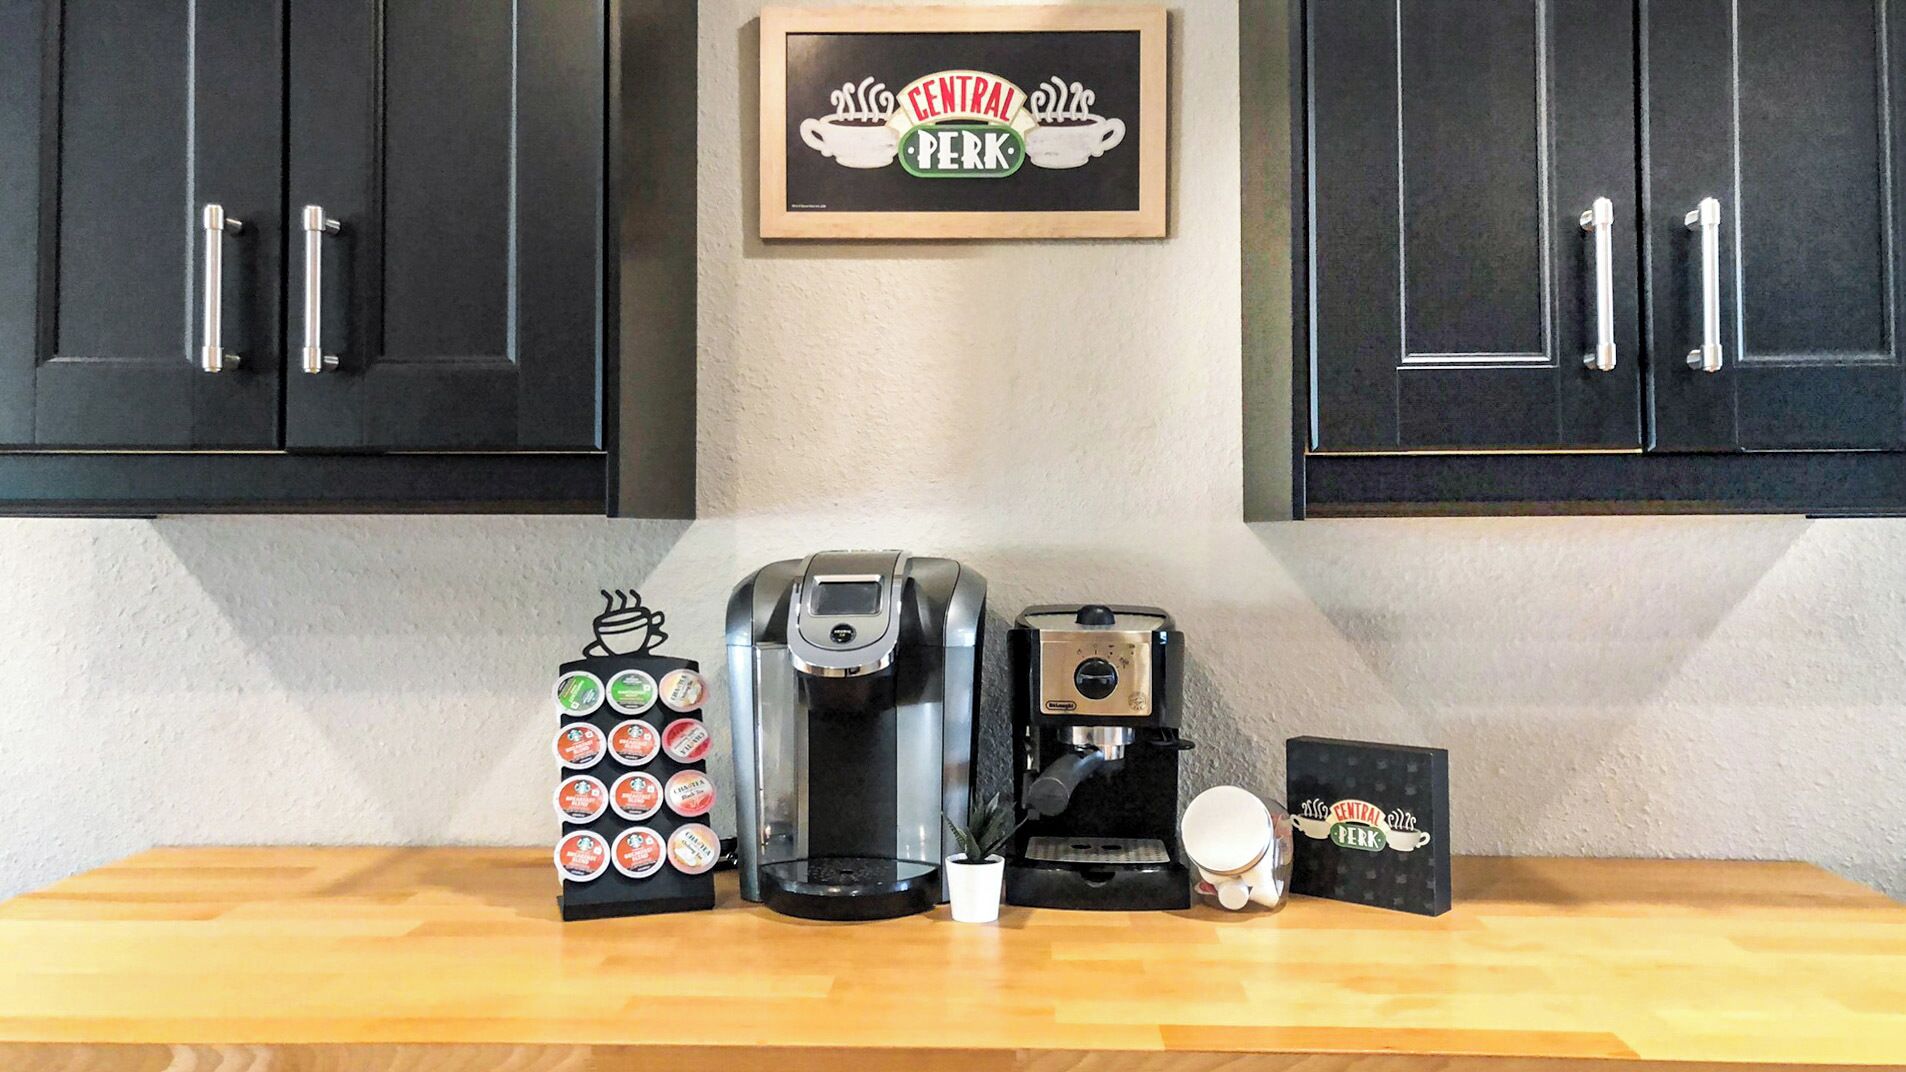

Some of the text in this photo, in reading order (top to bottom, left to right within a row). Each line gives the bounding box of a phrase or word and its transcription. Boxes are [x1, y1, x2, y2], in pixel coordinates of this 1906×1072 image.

[908, 75, 1014, 122] CENTRAL
[917, 129, 1010, 170] PERK
[1333, 801, 1381, 827] CENTRAL
[1338, 825, 1379, 849] PERK
